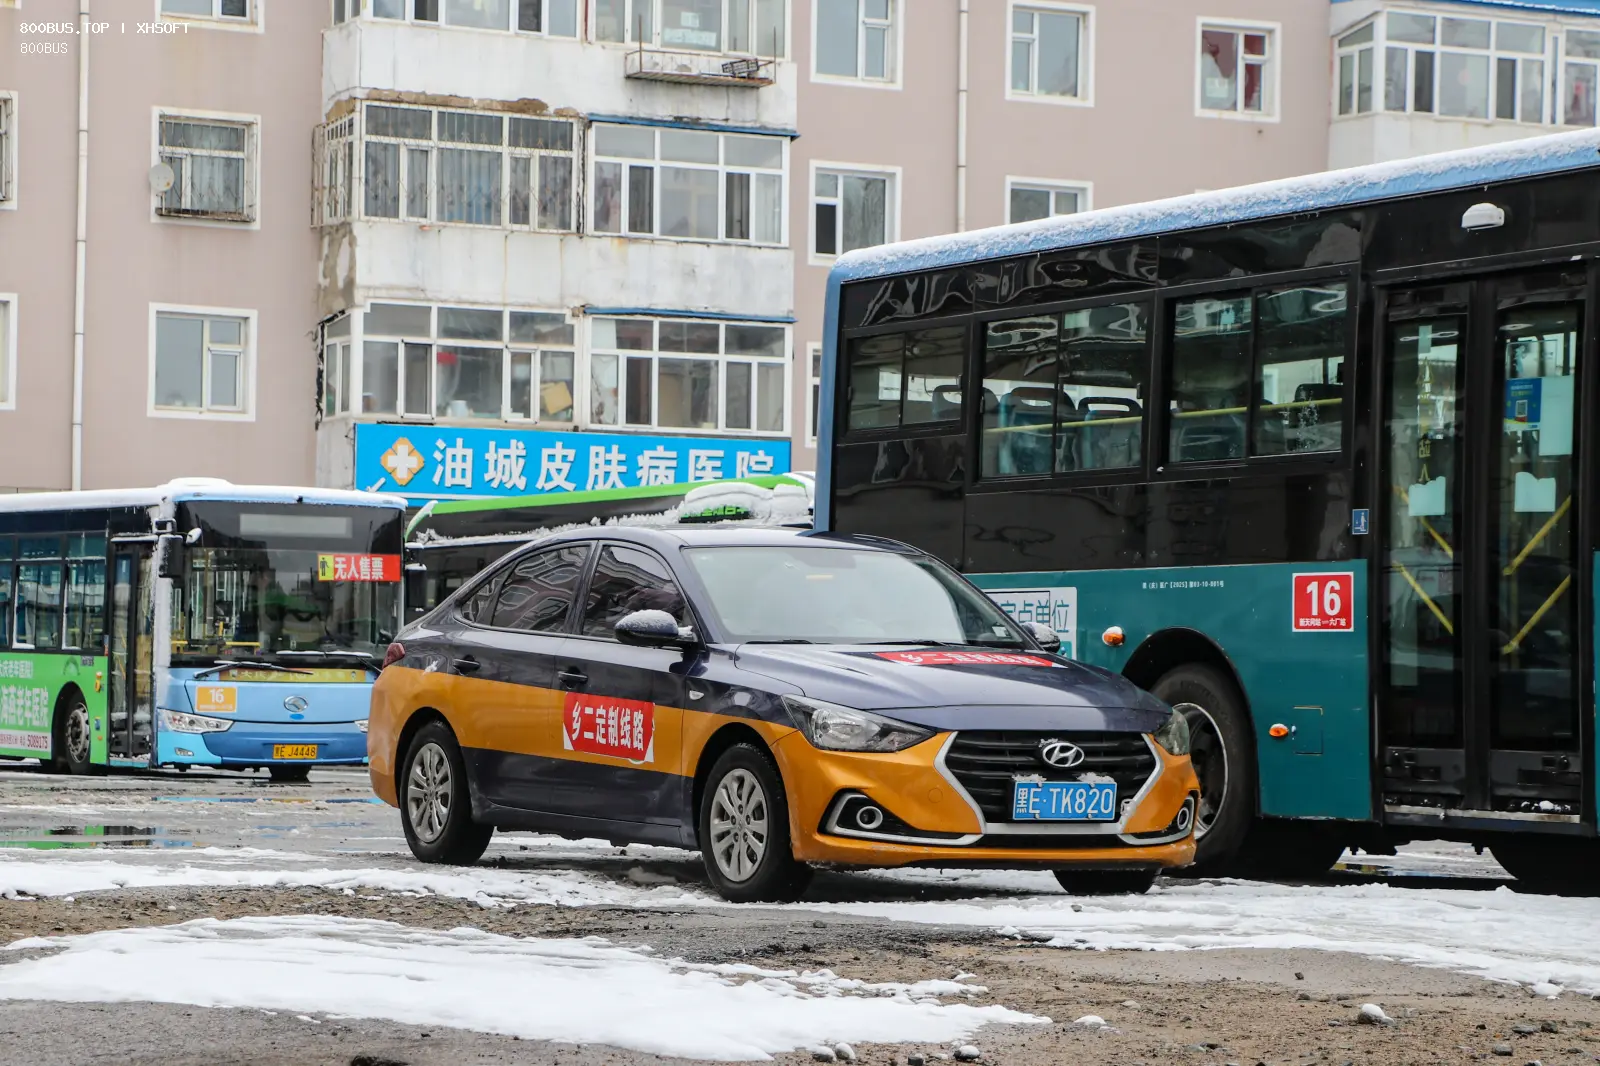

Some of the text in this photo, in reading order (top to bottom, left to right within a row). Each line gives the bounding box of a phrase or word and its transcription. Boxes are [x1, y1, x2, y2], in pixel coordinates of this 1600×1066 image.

[432, 437, 774, 491] 油城皮肤病医院
[334, 556, 384, 580] 无人售票
[1306, 580, 1341, 616] 16
[209, 688, 225, 704] 16
[572, 701, 644, 751] 乡二定制线路
[1016, 787, 1114, 814] 黑E·TK820
